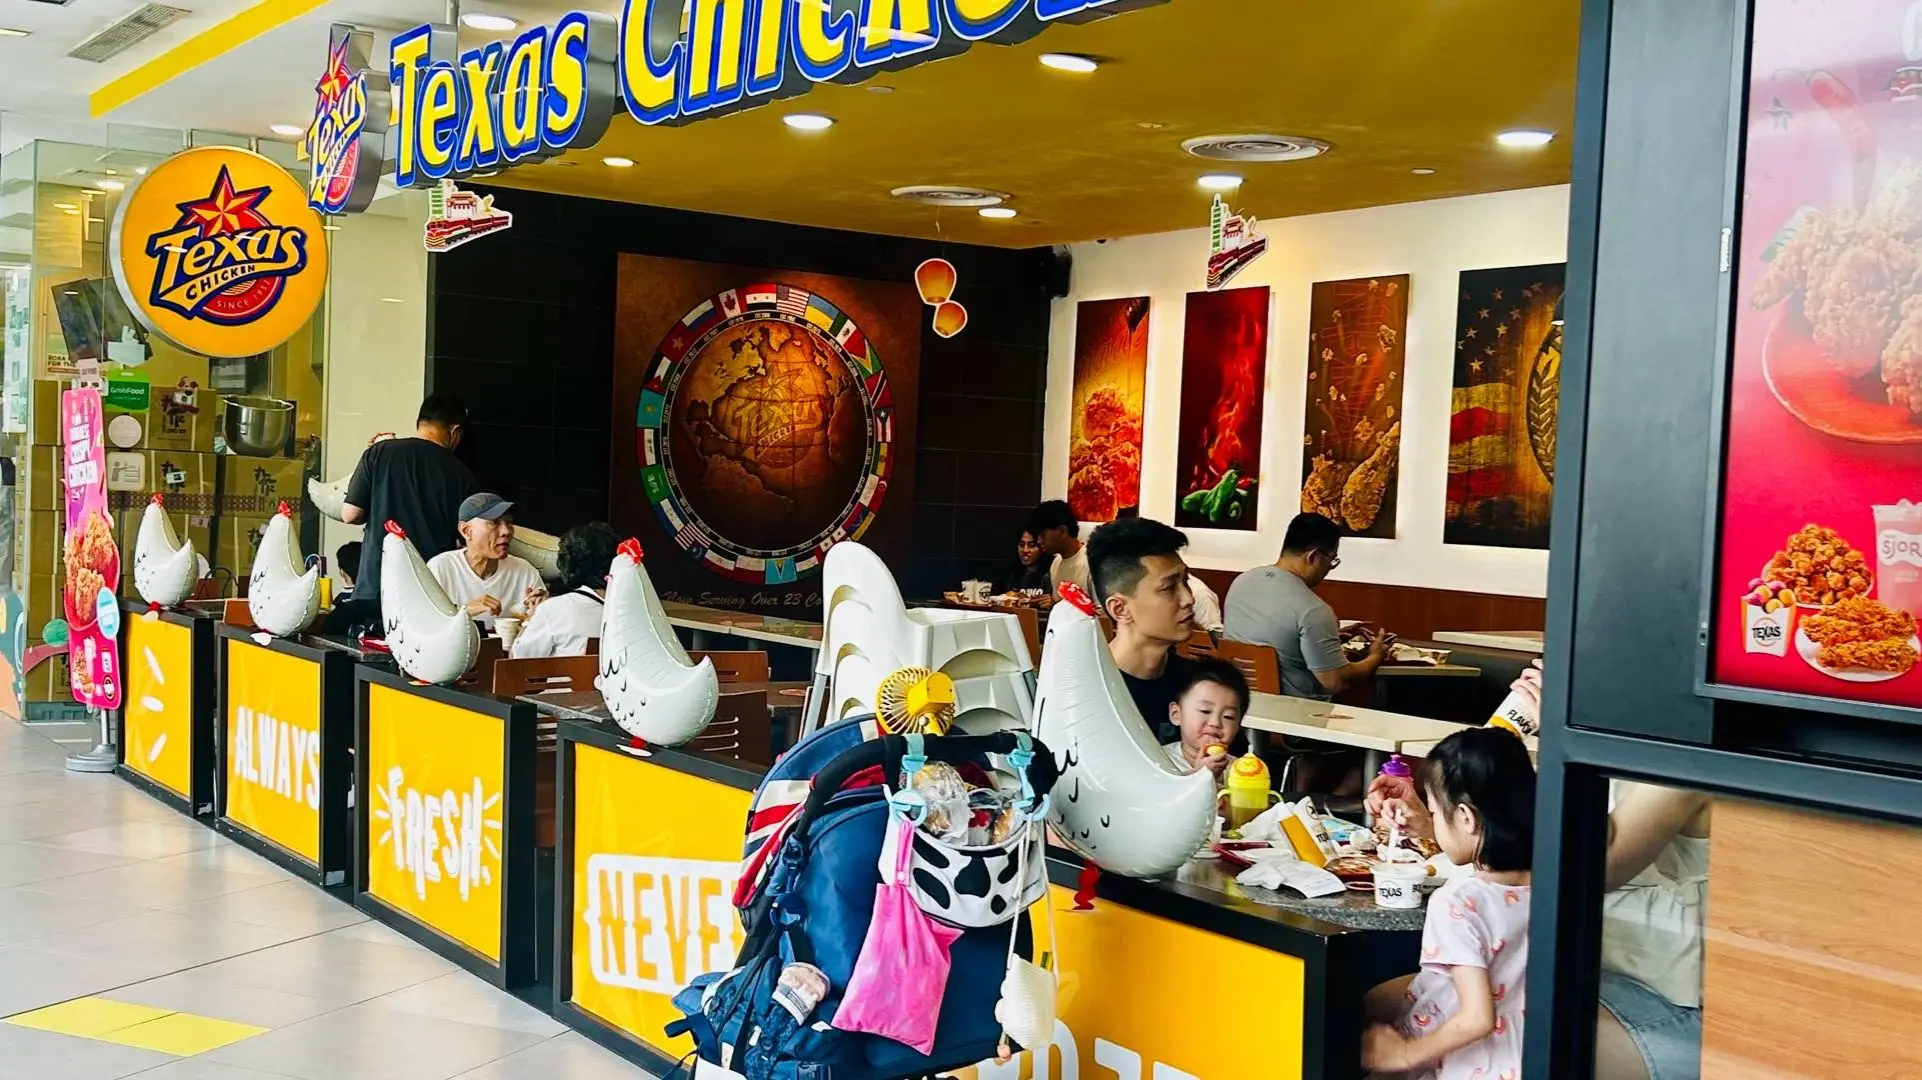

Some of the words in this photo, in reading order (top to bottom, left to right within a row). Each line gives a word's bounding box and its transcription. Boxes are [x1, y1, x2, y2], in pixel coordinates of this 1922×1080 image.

[391, 12, 589, 189] Texas
[307, 71, 367, 198] Texas
[152, 225, 302, 294] Texas
[185, 264, 256, 301] CHICKEN
[216, 299, 249, 310] SINCE
[751, 591, 779, 606] Over
[783, 592, 803, 606] 23
[1752, 625, 1781, 639] TEXAS
[234, 706, 320, 811] ALWAYS
[1378, 887, 1403, 899] TEXAS
[597, 869, 744, 985] NEVE
